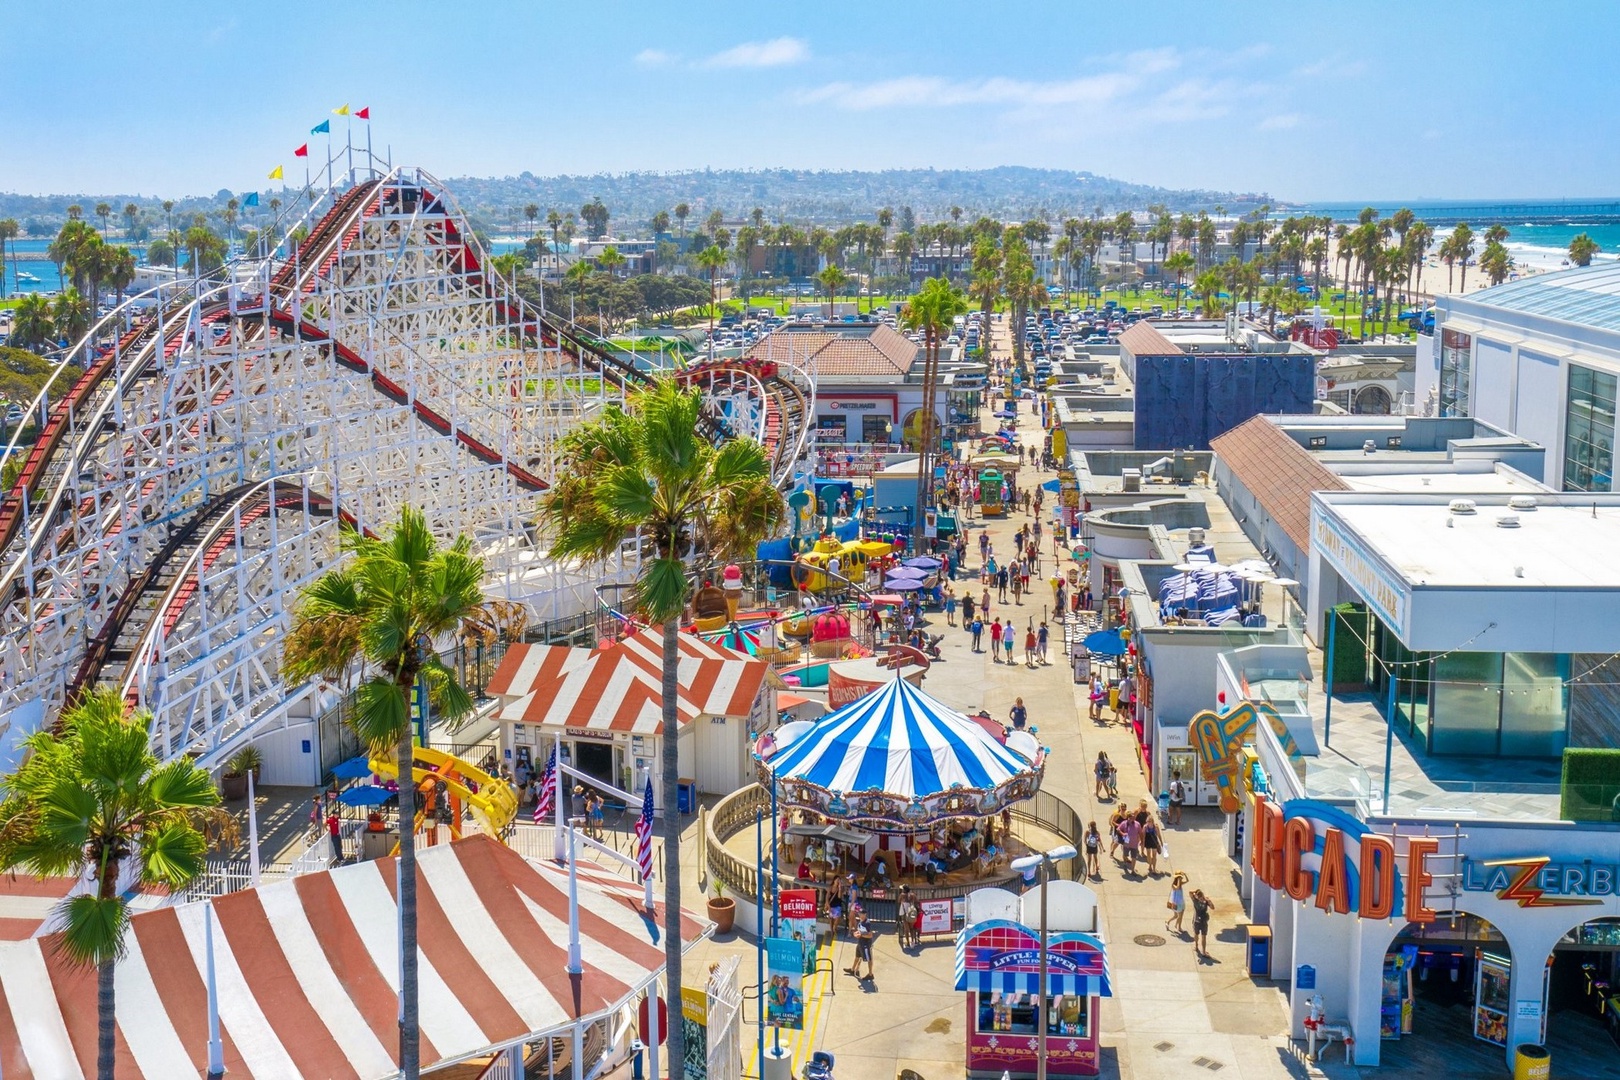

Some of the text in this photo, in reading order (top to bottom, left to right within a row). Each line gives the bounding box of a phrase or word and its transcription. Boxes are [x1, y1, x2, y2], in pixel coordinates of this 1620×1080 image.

[1377, 579, 1398, 620] PARK
[1251, 792, 1439, 923] RCADE
[1463, 857, 1620, 908] LAZERB
[783, 902, 814, 911] BELMONT
[770, 952, 800, 964] BELMONT
[993, 951, 1033, 967] LITTLE
